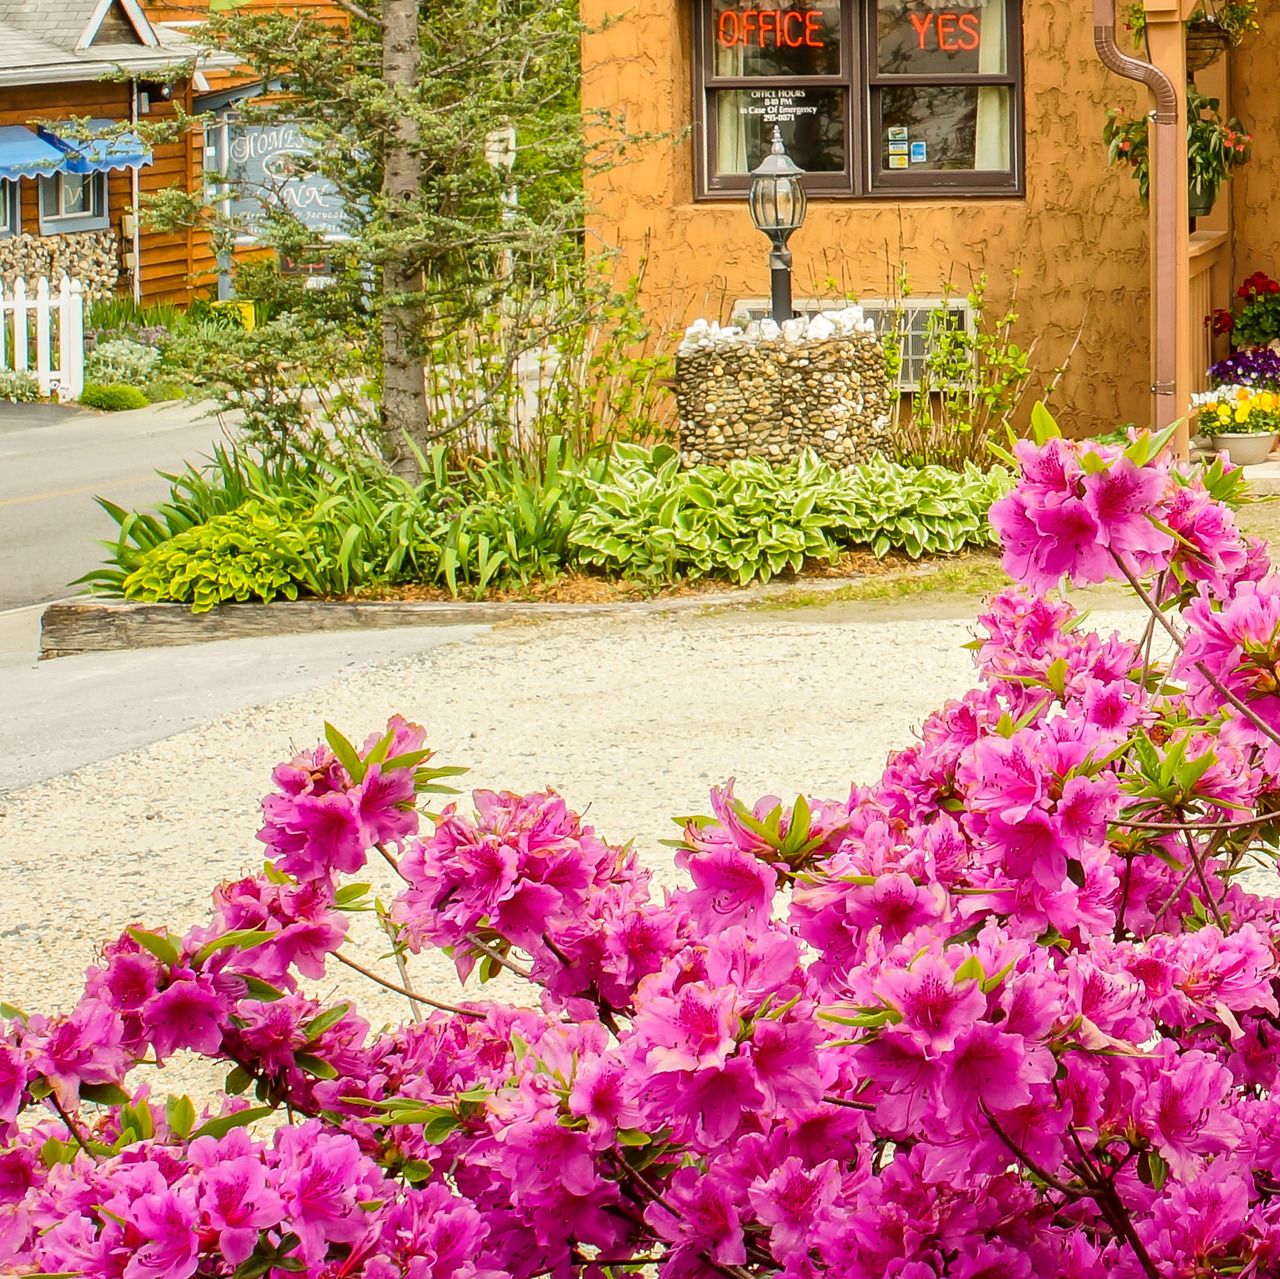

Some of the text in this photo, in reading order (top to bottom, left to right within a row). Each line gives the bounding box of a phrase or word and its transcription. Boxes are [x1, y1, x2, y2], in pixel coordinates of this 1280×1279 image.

[718, 10, 824, 48] OFFICE
[910, 13, 980, 51] YES
[748, 106, 766, 114] Case
[767, 105, 778, 114] Of
[779, 106, 817, 115] Emergency
